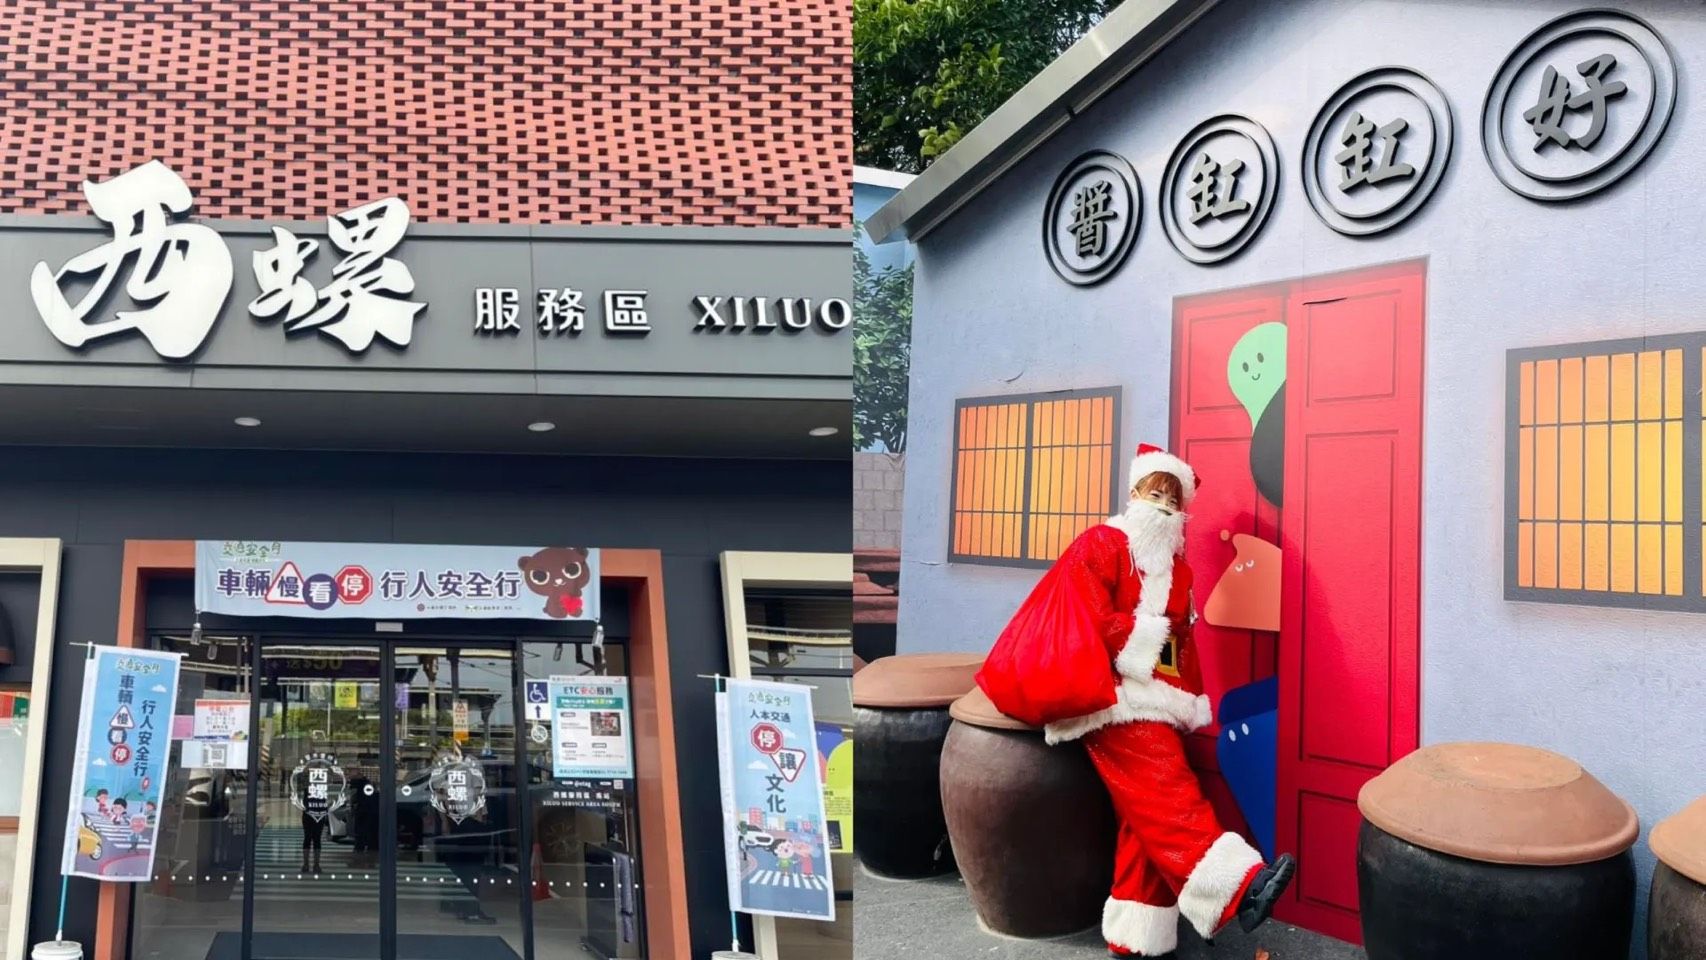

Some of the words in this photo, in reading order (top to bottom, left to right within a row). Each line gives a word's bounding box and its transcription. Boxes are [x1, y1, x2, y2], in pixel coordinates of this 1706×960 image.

[30, 159, 427, 358] 西螺
[474, 287, 651, 336] 服務區
[694, 297, 852, 331] XILUO
[381, 570, 521, 598] 行人安全行
[750, 709, 791, 723] 人本交通
[133, 700, 156, 776] 行人安全行
[308, 768, 328, 799] 西螺
[447, 770, 467, 801] 西螺
